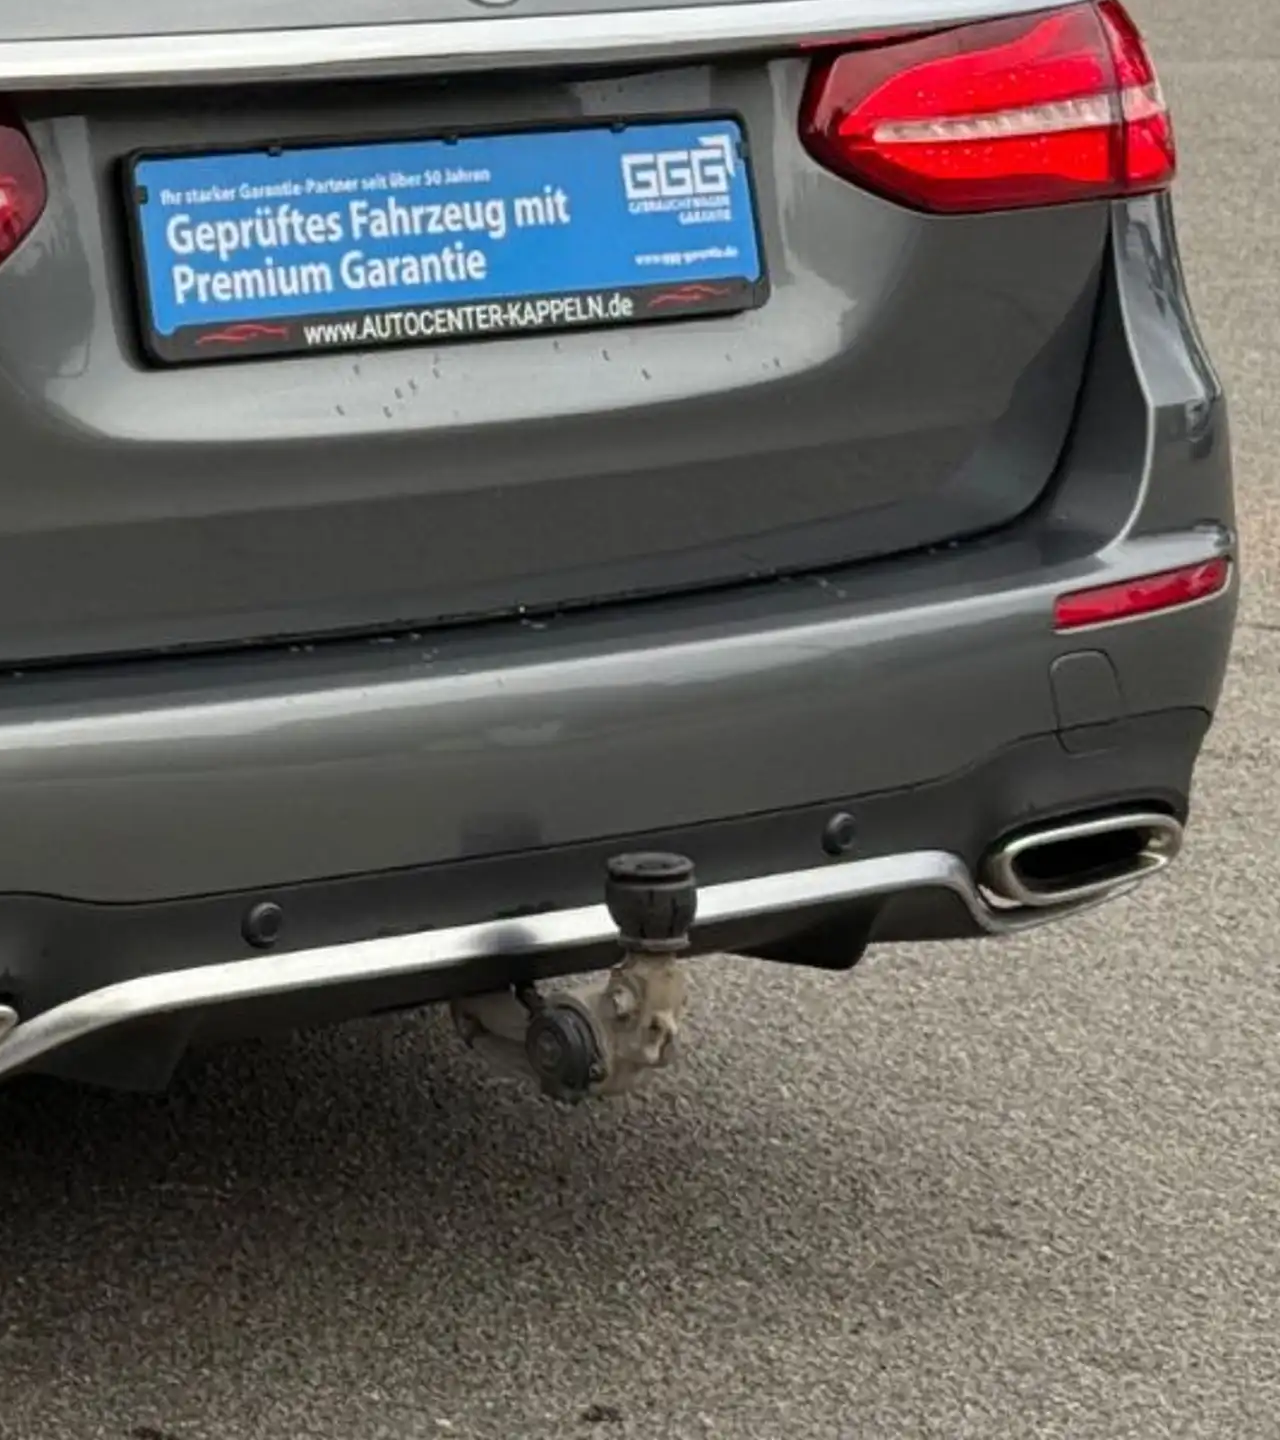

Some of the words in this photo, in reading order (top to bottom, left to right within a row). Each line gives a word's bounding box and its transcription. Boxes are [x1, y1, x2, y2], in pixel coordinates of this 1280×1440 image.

[160, 189, 184, 205] Ihr
[186, 187, 237, 203] starker
[239, 176, 359, 200] Garantie-Partner
[361, 175, 387, 191] seit
[389, 171, 421, 189] über
[443, 168, 491, 185] Jahren
[621, 148, 730, 199] GGG
[166, 203, 343, 260] Geprüftes
[349, 191, 507, 241] Fahrzeug
[514, 184, 571, 225] mit
[172, 257, 333, 305] Premium
[339, 241, 487, 291] Garantie
[303, 293, 634, 345] www.AUTOCENTER-KAPPELN.de
